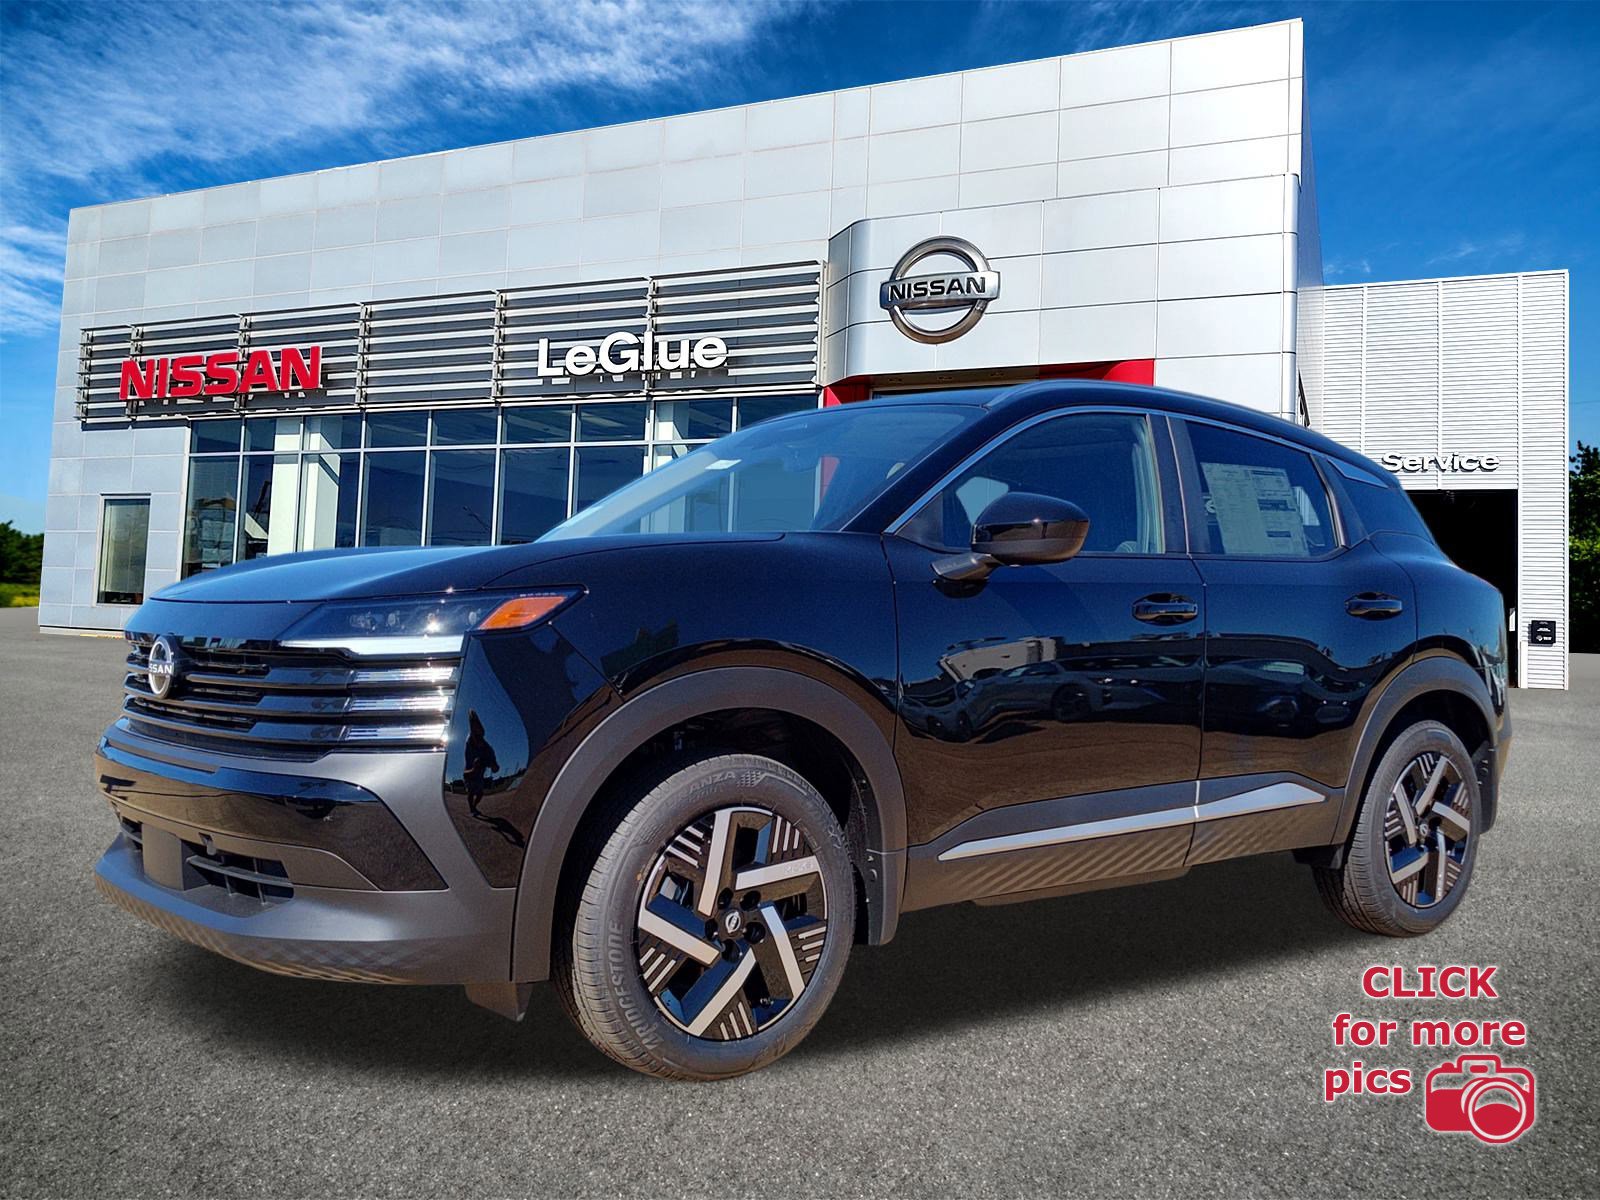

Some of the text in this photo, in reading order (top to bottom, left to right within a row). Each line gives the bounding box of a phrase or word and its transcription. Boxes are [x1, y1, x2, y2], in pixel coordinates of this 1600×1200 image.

[888, 276, 986, 301] NISSAN
[537, 332, 728, 377] LeGlue
[119, 346, 321, 400] NISSAN
[1383, 451, 1500, 473] Service
[149, 663, 172, 673] SSAN
